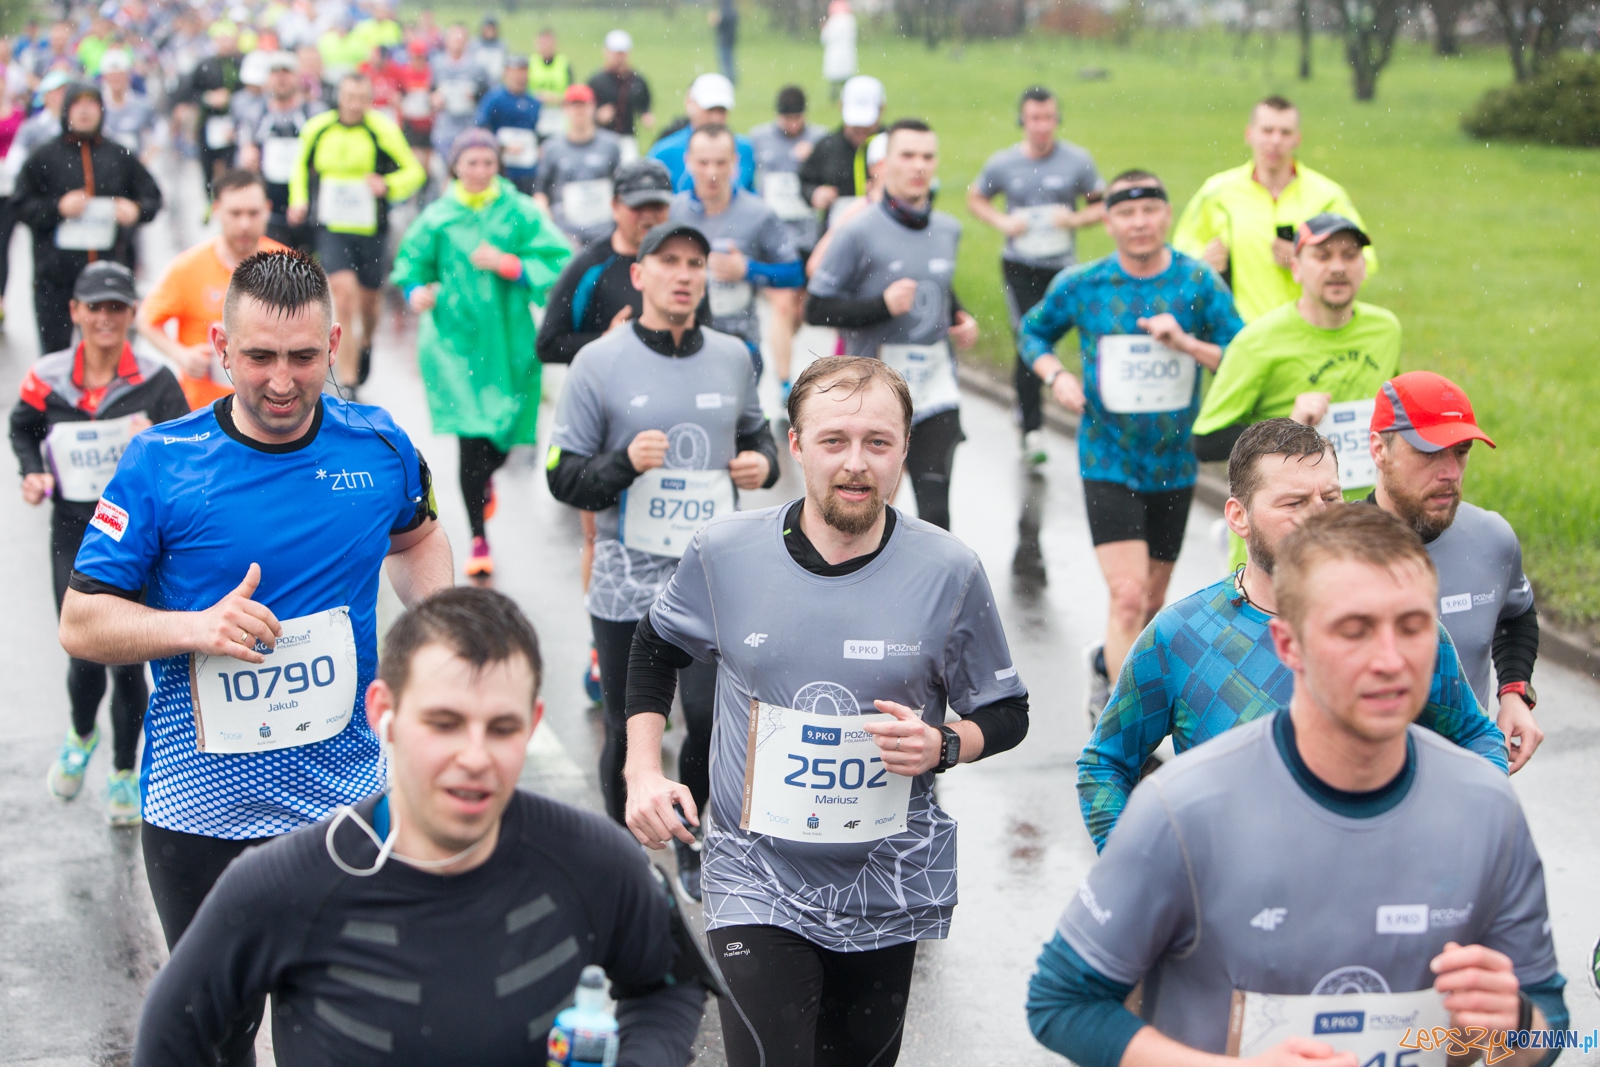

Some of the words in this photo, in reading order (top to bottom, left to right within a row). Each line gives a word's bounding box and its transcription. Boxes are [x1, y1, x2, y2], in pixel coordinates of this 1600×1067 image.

[1121, 359, 1180, 379] 3500
[71, 442, 128, 467] 884
[329, 468, 374, 490] ztm
[649, 498, 715, 521] 8709
[1453, 599, 1468, 607] PKO
[743, 632, 769, 648] 4F
[859, 646, 878, 654] PKO
[218, 655, 335, 702] 10790
[267, 700, 298, 712] Jakub
[295, 721, 311, 732] 4F
[815, 732, 835, 741] PKO
[844, 731, 873, 739] POZna
[784, 753, 888, 790] 2502
[815, 795, 859, 804] Mariusz
[843, 820, 861, 829] 4F
[1250, 907, 1288, 931] 4F
[723, 949, 751, 957] Kalenji
[1331, 1015, 1359, 1028] PKO
